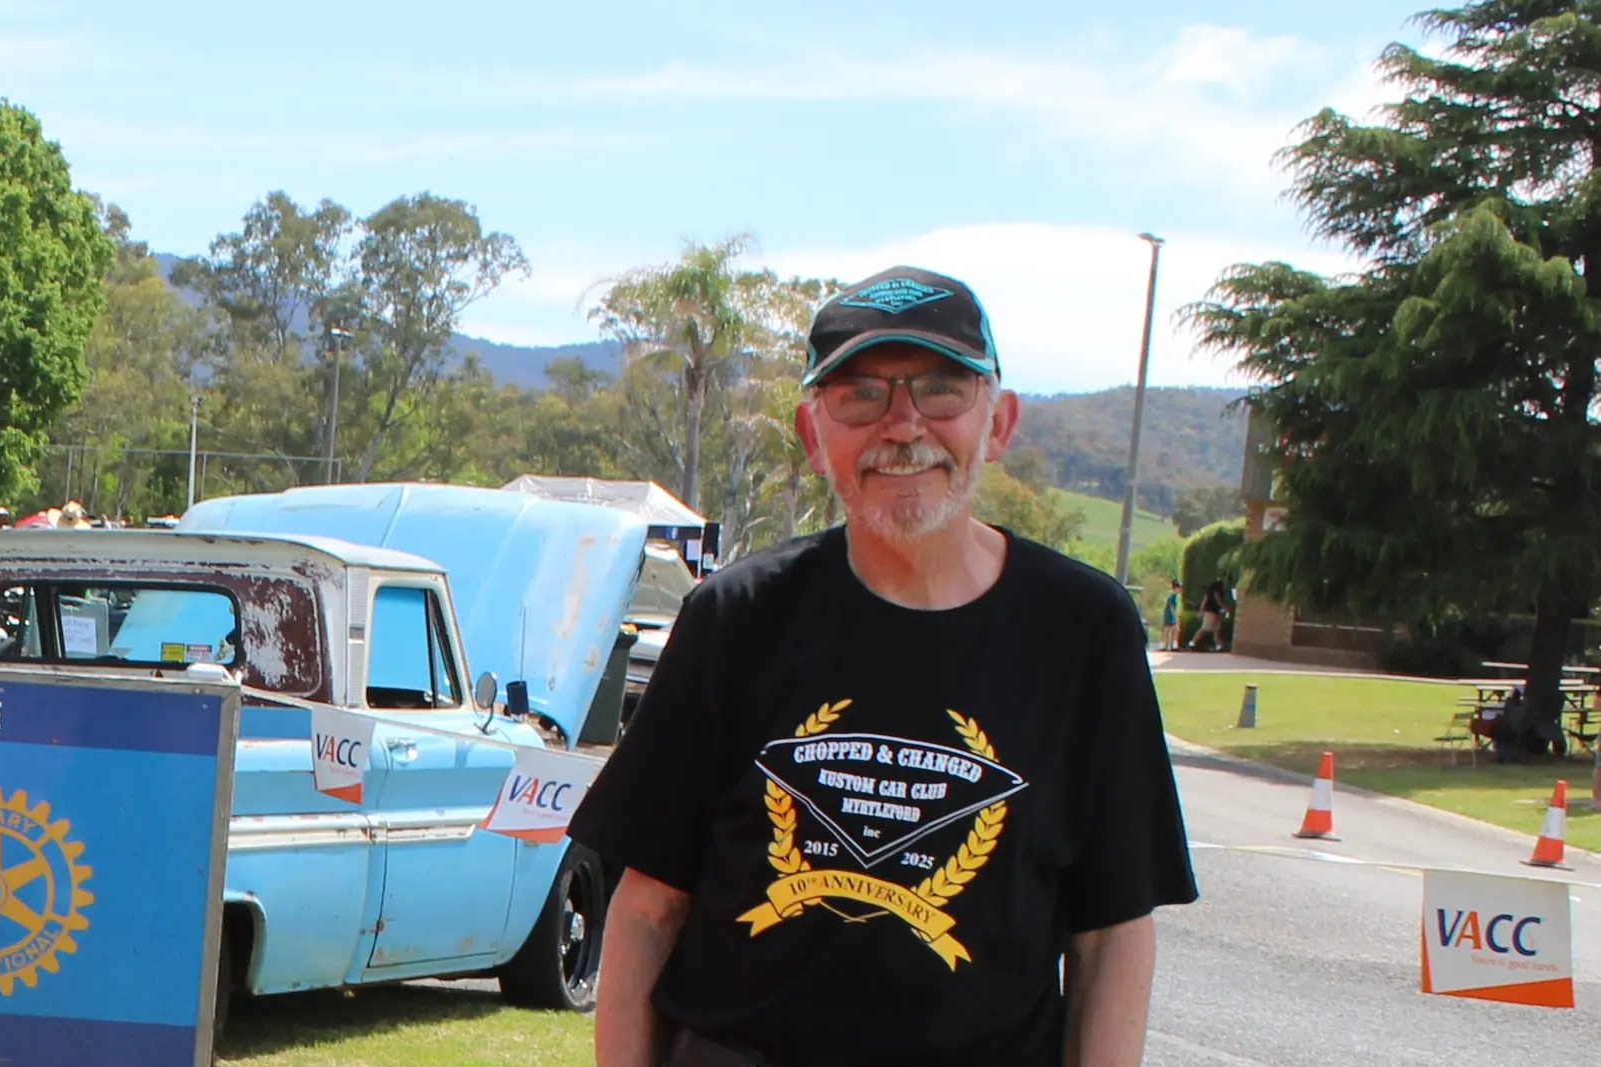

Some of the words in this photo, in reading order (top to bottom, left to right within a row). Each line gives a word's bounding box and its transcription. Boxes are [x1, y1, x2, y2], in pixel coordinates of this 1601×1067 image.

[316, 733, 361, 768] VACC
[793, 741, 873, 764] CHOPPED
[876, 745, 893, 765] &
[897, 751, 983, 784] CHANGED
[509, 774, 572, 812] VACC
[818, 768, 876, 795] KUSTOM
[878, 779, 907, 798] CAR
[910, 782, 948, 800] CLUB
[841, 797, 921, 823] MYRTLEFORD
[803, 840, 839, 857] 2015
[900, 852, 935, 870] 2025
[819, 874, 934, 924] ANNIVERSARY
[1437, 908, 1542, 956] VACC
